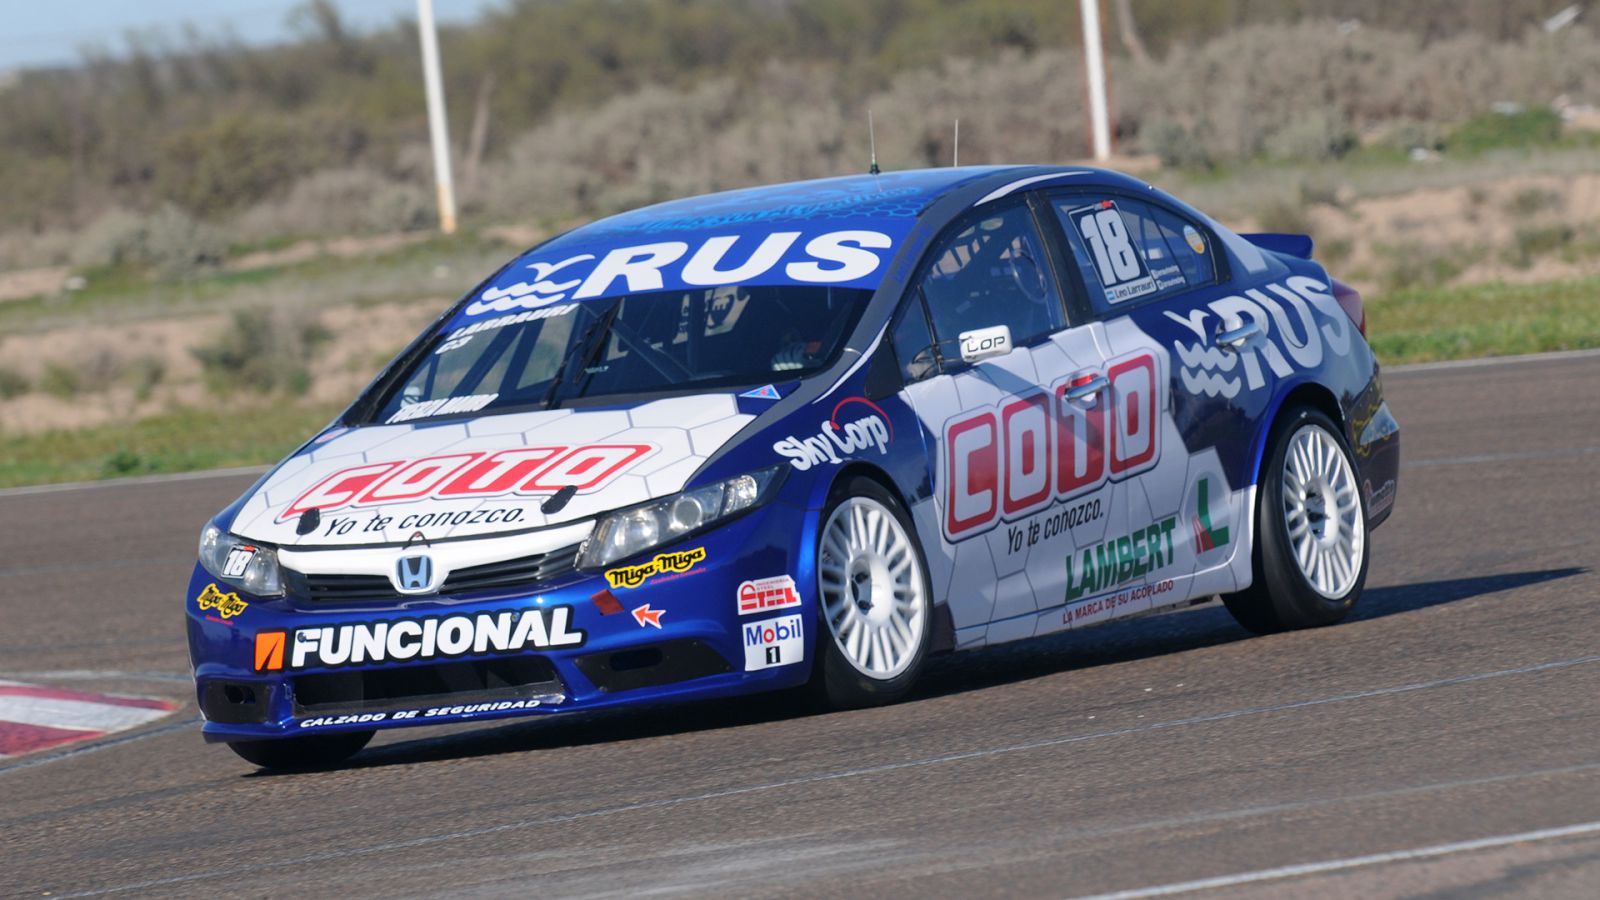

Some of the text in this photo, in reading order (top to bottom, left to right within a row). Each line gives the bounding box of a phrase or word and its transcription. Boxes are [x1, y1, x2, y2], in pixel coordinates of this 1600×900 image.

[571, 230, 892, 300] RUS
[1080, 208, 1140, 286] 18
[1207, 275, 1350, 391] RUS
[949, 353, 1156, 536] COTO
[280, 444, 655, 518] COTO
[323, 507, 527, 538] Yo te conozco.
[1007, 499, 1104, 555] Yo te conozco.
[223, 548, 254, 577] 18
[1065, 517, 1177, 602] LAMBERT
[292, 607, 583, 668] FUNCIONAL
[746, 618, 801, 647] Mobil
[1063, 610, 1074, 625] LA
[301, 700, 541, 728] CALZADO DE SEGURIDAD
